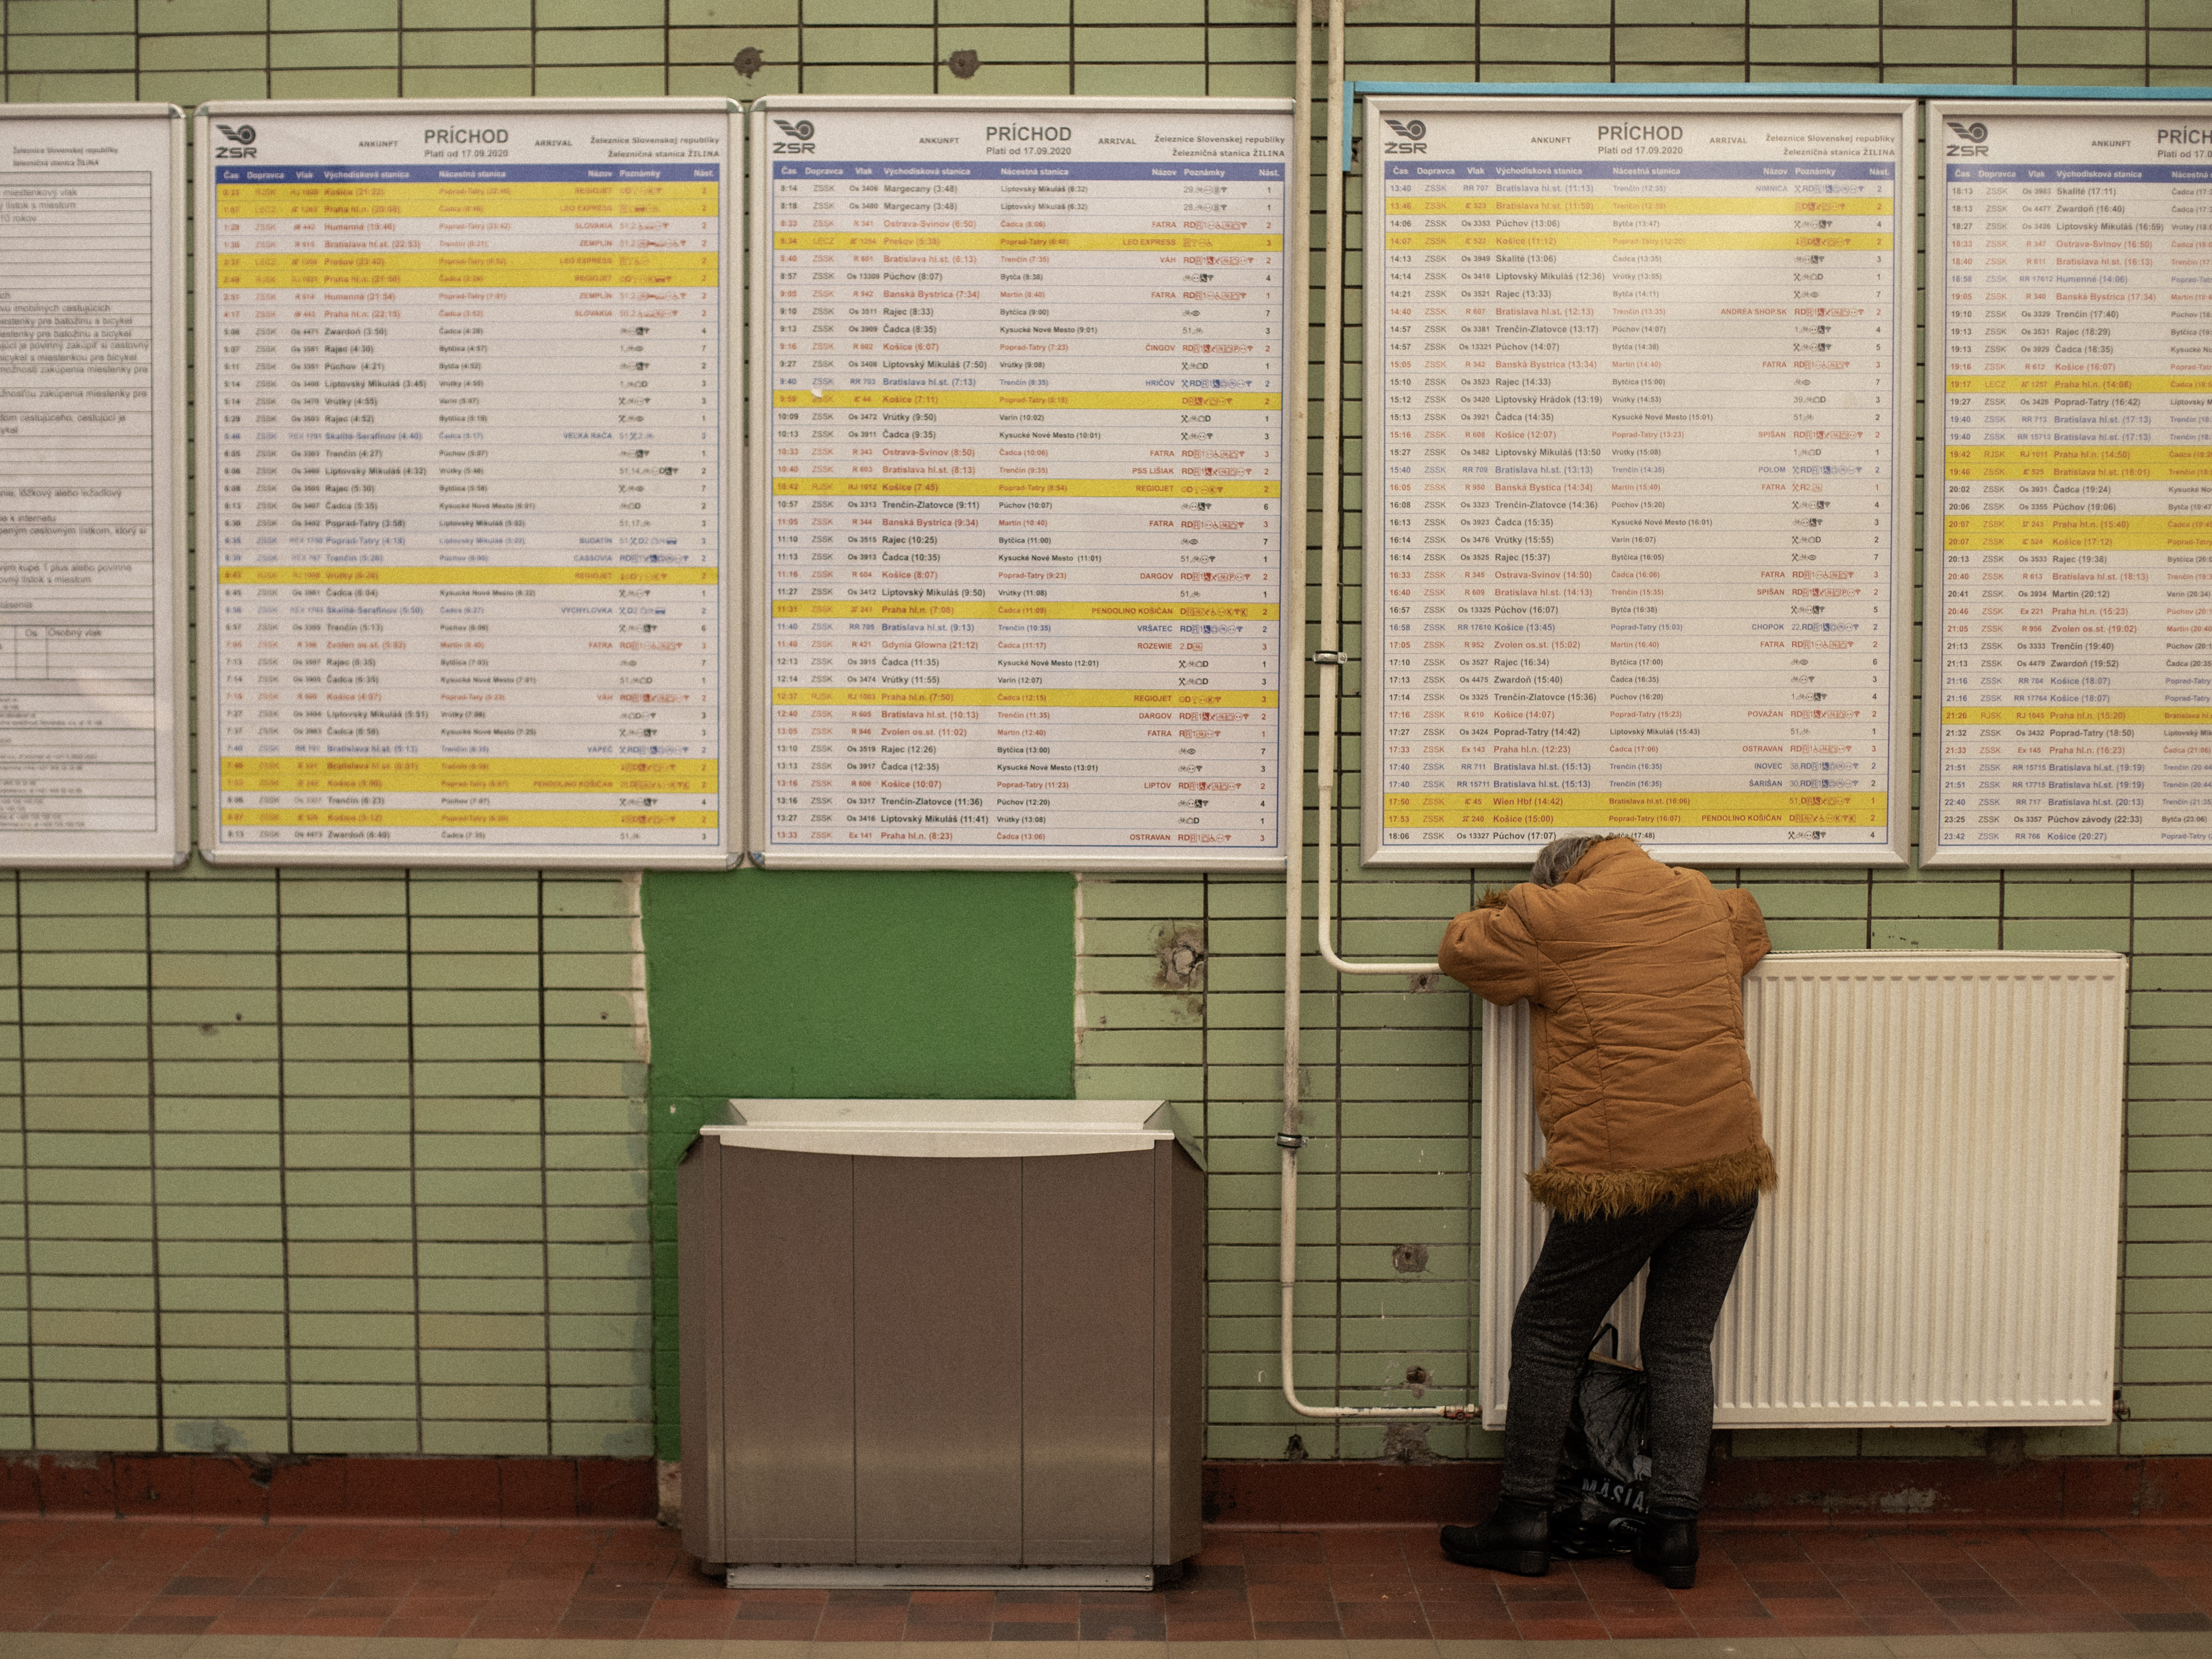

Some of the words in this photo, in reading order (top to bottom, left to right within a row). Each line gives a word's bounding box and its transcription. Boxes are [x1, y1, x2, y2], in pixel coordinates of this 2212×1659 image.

[424, 124, 509, 144] PRÍCHOD
[986, 123, 1072, 142] PRÍCHOD
[1598, 120, 1683, 141] PRÍCHOD
[1154, 134, 1195, 142] Železnice
[1196, 136, 1243, 145] Slovenskej
[1245, 136, 1286, 145] republiky
[1765, 133, 1805, 142] Železnice
[1807, 135, 1853, 143] Slovenskej
[1855, 135, 1896, 143] republiky
[215, 146, 257, 159] ŽSR
[773, 141, 816, 154] ŽSR
[1024, 146, 1071, 155] 17.09.2020
[1172, 148, 1217, 157] Železničná
[1253, 148, 1286, 157] ŽILINA
[1384, 142, 1427, 154] ŽSR
[1620, 146, 1633, 155] od
[1635, 146, 1683, 155] 17.09.2020
[1783, 146, 1828, 156] Železničná
[1863, 147, 1896, 156] ŽILINA
[1946, 144, 1989, 157] ŽSR
[447, 150, 459, 158] od
[2180, 150, 2191, 158] od
[223, 170, 239, 179] Čas
[781, 165, 797, 174] Čas
[805, 167, 844, 176] Dopravca
[1184, 169, 1225, 178] Poznámky
[1393, 165, 1408, 174] Čas
[1417, 167, 1455, 176] Dopravca
[1467, 167, 1485, 175] Vlak
[1794, 167, 1836, 177] Poznámky
[1955, 169, 1971, 177] Čas
[1977, 169, 2016, 179] Dopravca
[1493, 675, 1532, 684] Zwardoň
[1533, 675, 1563, 685] (15:40)
[1610, 674, 1633, 683] Čadca
[1635, 676, 1659, 684] (16:35)
[1493, 727, 1549, 737] Poprad-Tatry
[1551, 727, 1581, 737] (14:42)
[1610, 728, 1645, 736] Liptovský
[1675, 728, 1700, 736] (15:43)
[1389, 745, 1410, 754] 17:33
[1493, 745, 1519, 754] Praha
[1520, 745, 1539, 753] hl.n.
[1541, 745, 1571, 755] (12:23)
[1609, 744, 1632, 753] Čadca
[1634, 745, 1659, 754] (17:06)
[881, 797, 952, 806] Trenčín-Zlatovce
[954, 798, 983, 807] (11:36)
[1026, 798, 1050, 807] (12:20)
[880, 815, 923, 825] Liptovský
[925, 815, 958, 823] Mikuláš
[960, 815, 989, 825] (11:41)
[996, 816, 1020, 824] Vrútky
[2047, 815, 2079, 823] Púchov
[2081, 815, 2112, 825] závody
[2114, 815, 2143, 825] (22:33)
[2161, 816, 2182, 824] Bytča
[1582, 1477, 1649, 1514] MÄSIA
